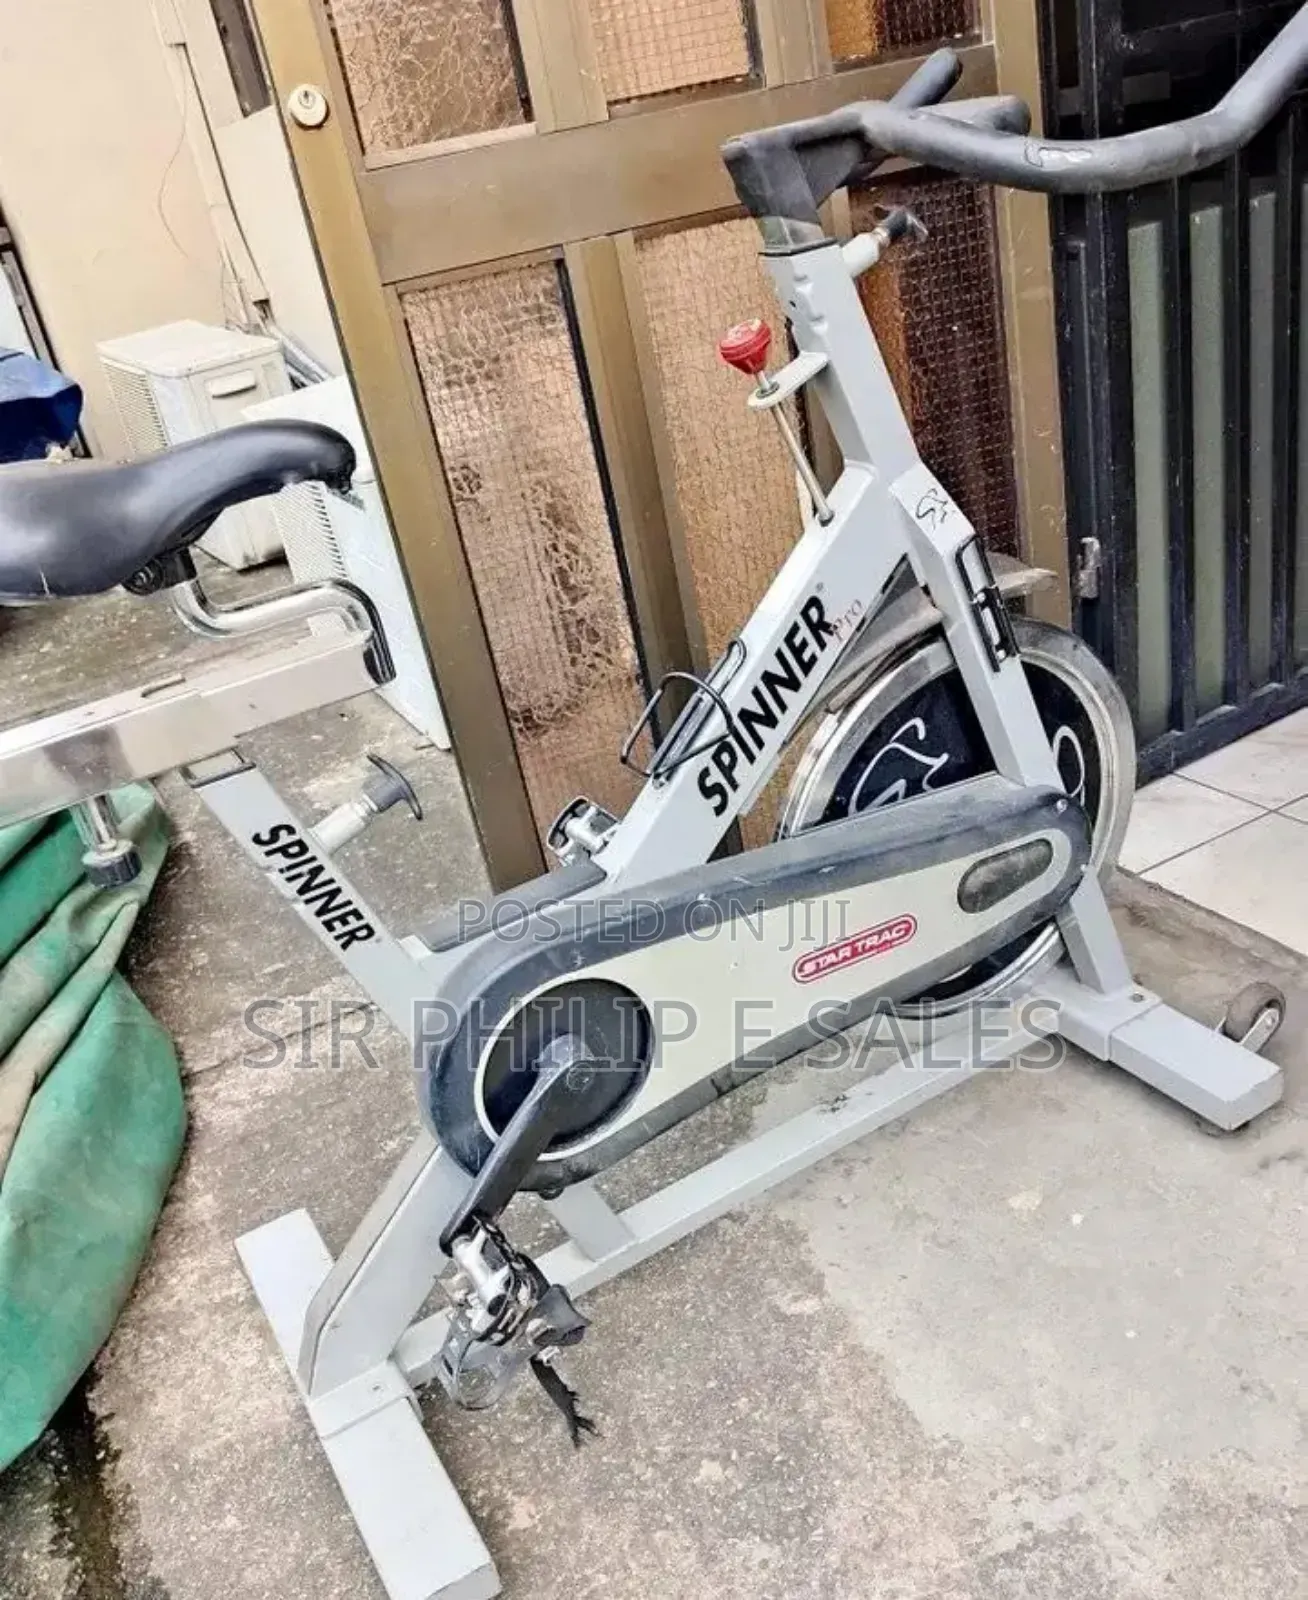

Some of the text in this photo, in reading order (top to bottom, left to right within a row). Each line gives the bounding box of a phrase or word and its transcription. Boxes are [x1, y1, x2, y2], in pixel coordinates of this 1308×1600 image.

[697, 595, 836, 817] SPINNER
[251, 823, 376, 952] SPINNER
[800, 925, 909, 975] STAR TRAC
